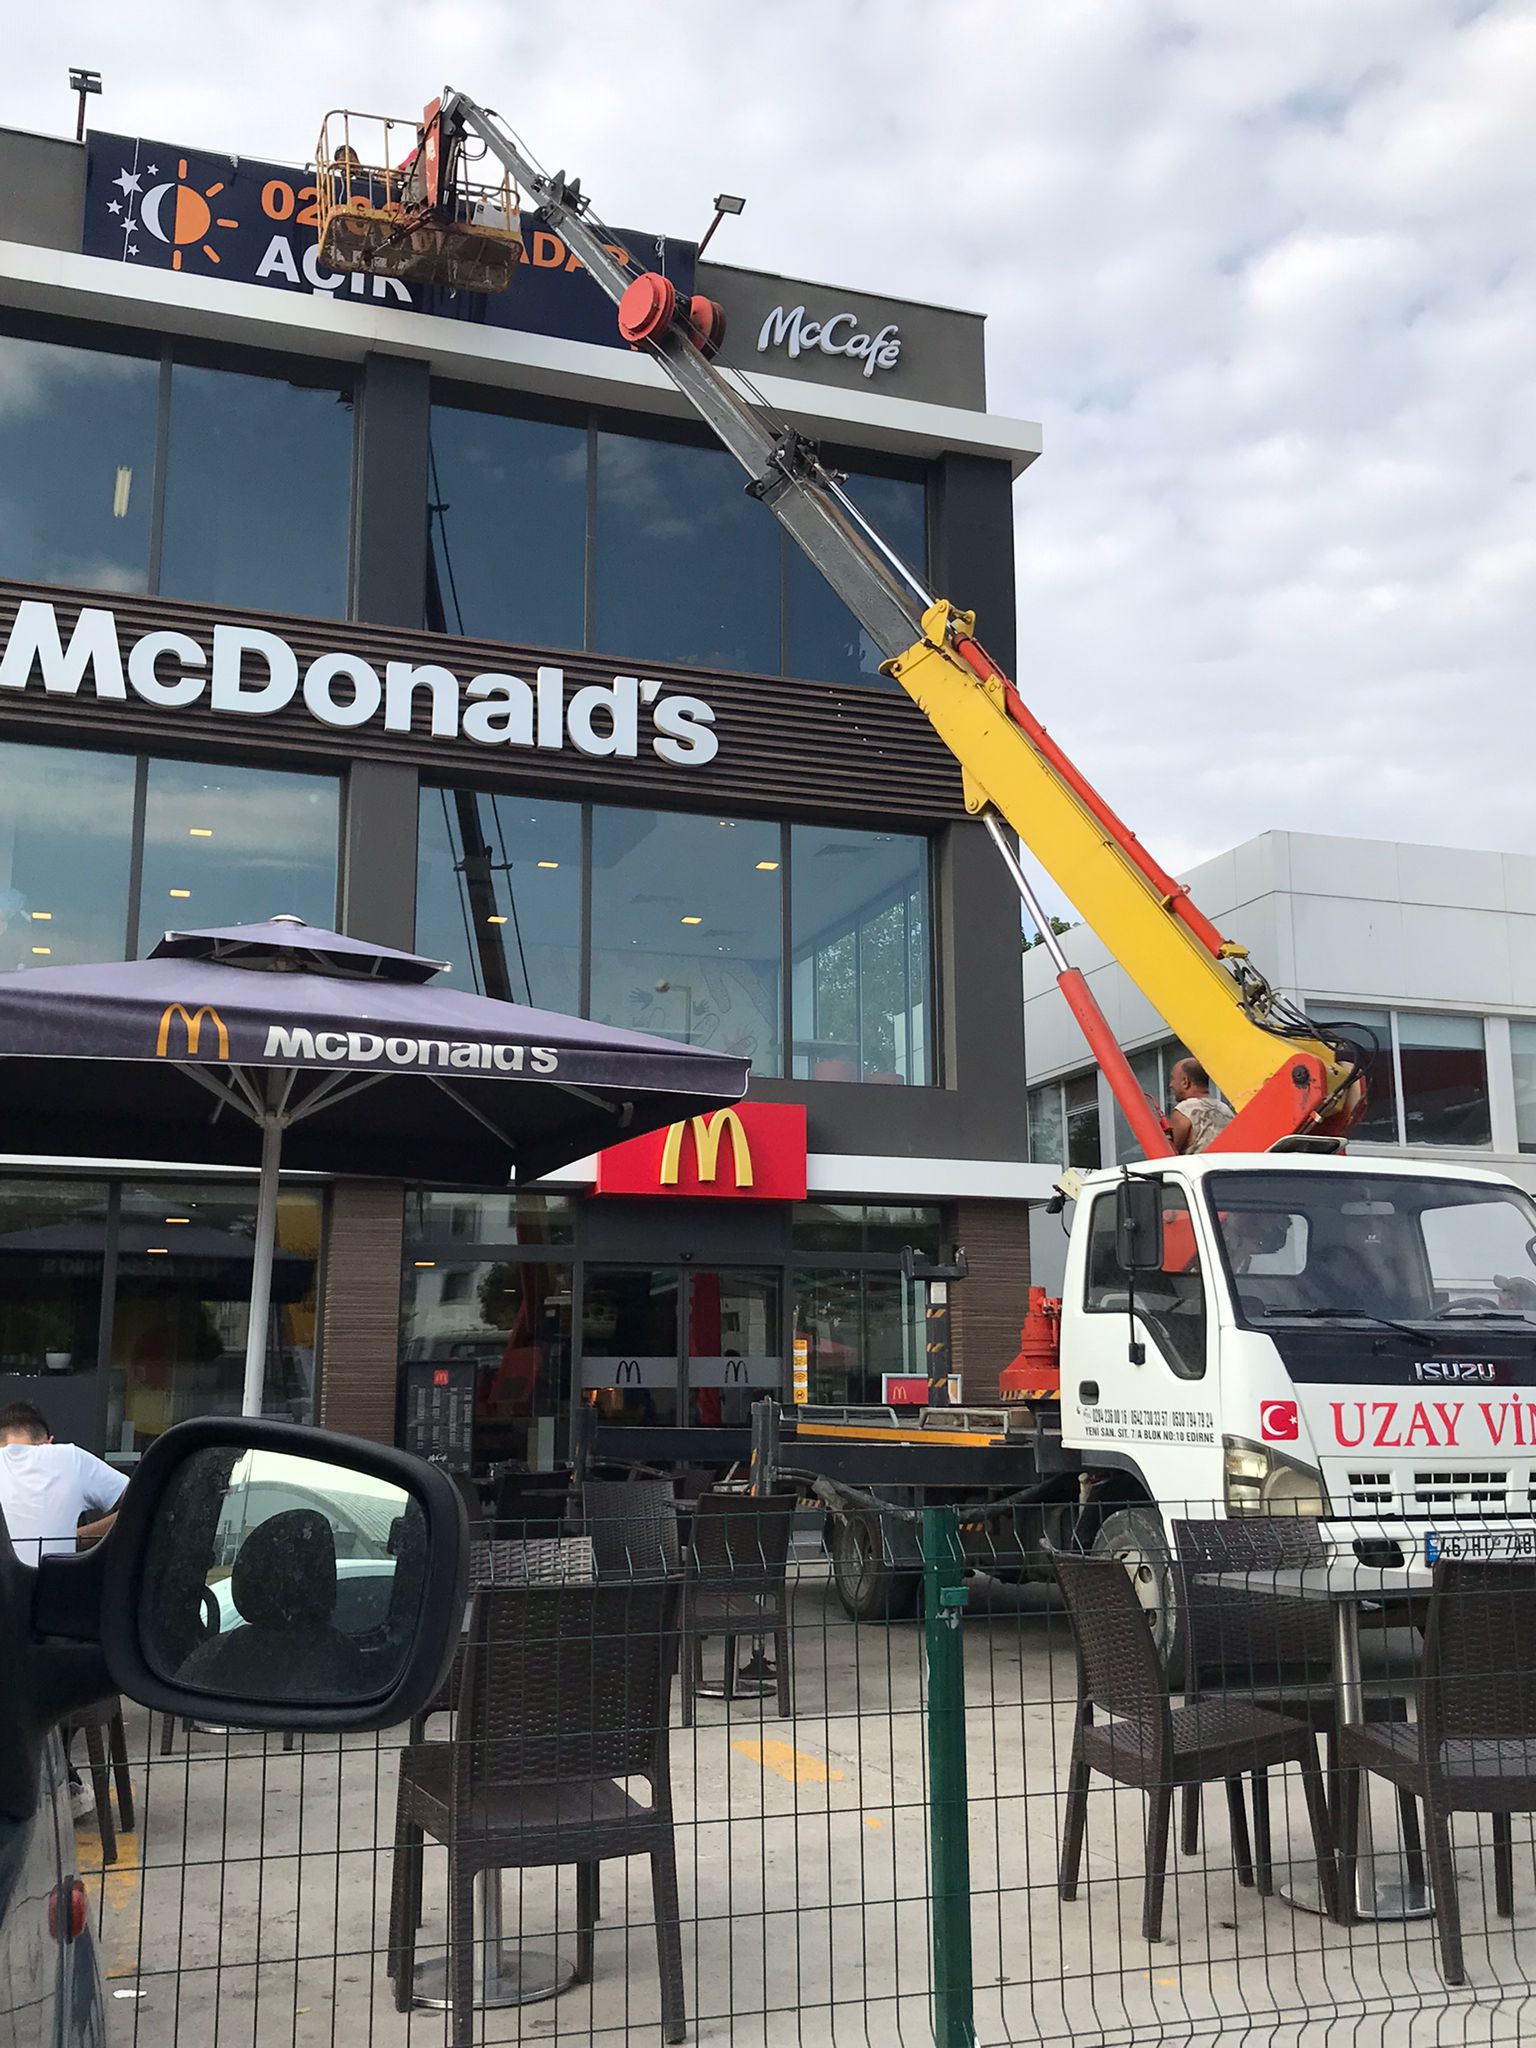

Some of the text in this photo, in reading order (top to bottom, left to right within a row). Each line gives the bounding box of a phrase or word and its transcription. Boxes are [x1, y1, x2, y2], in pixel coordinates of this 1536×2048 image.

[757, 305, 901, 378] McCafé
[0, 600, 720, 768] McDonald's
[263, 1025, 559, 1074] McDonalds
[1414, 1362, 1496, 1381] ISUZU
[1143, 1429, 1161, 1440] BLOK
[1329, 1392, 1536, 1448] UZAY Vİ
